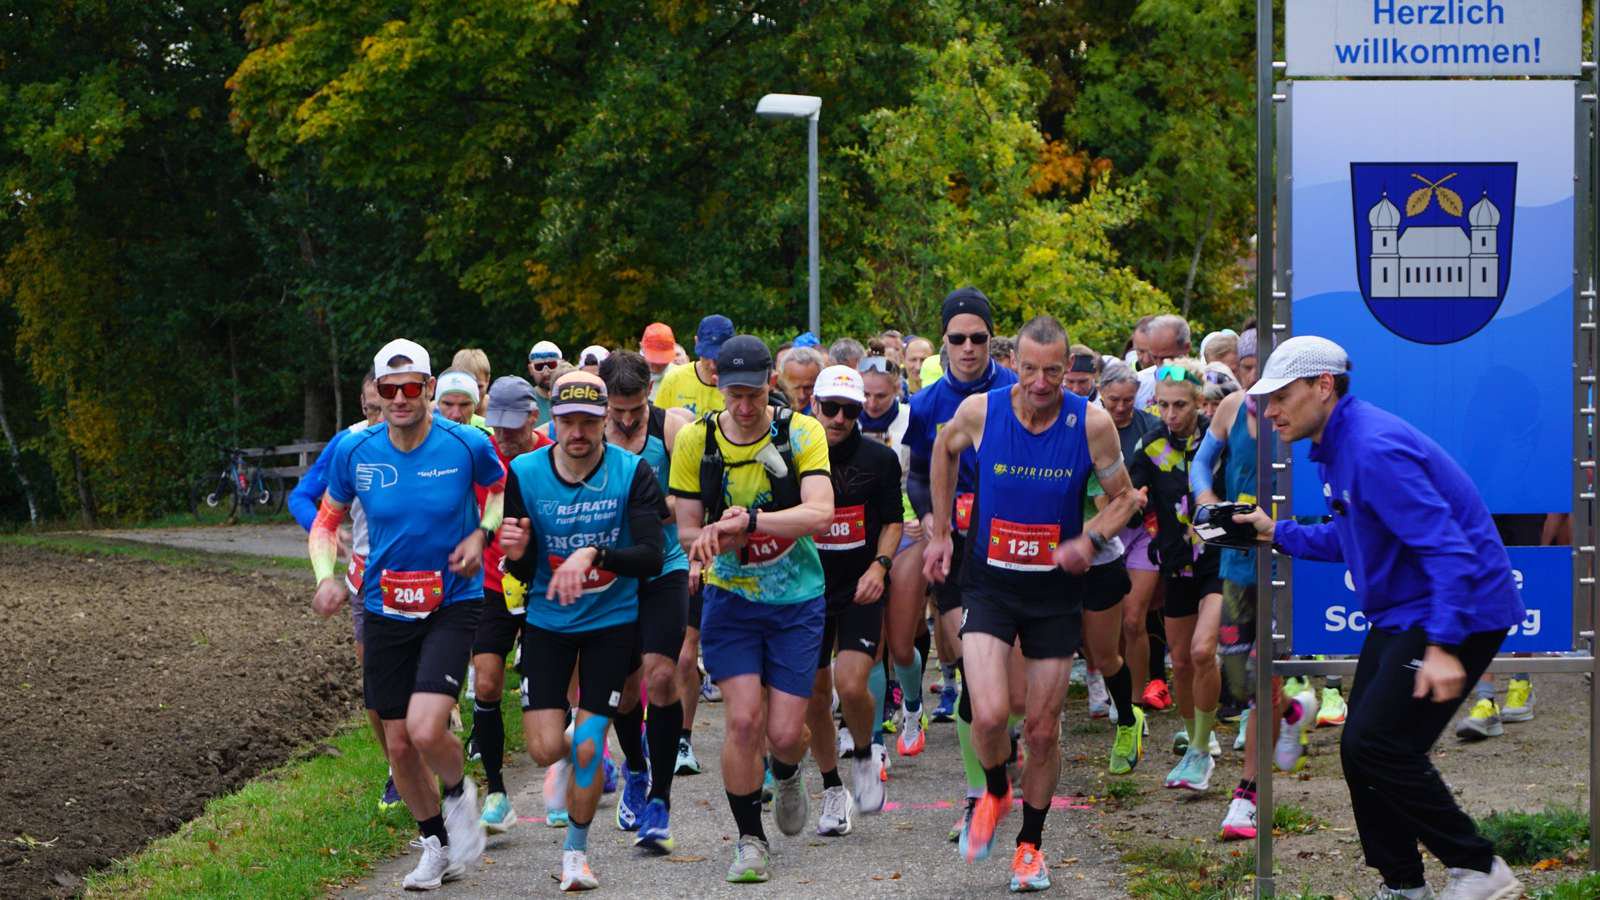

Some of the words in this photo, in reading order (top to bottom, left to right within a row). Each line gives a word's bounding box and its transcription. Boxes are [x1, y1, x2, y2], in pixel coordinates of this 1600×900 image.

[1374, 0, 1504, 24] Herzlich
[1335, 38, 1541, 64] willkommen!
[560, 385, 599, 401] ciele
[1010, 465, 1073, 478] SPIRIDON
[556, 499, 618, 515] REFRATH
[593, 511, 617, 520] team
[824, 522, 850, 537] 08
[751, 538, 779, 556] 141
[1008, 538, 1040, 557] 125
[394, 587, 425, 604] 204
